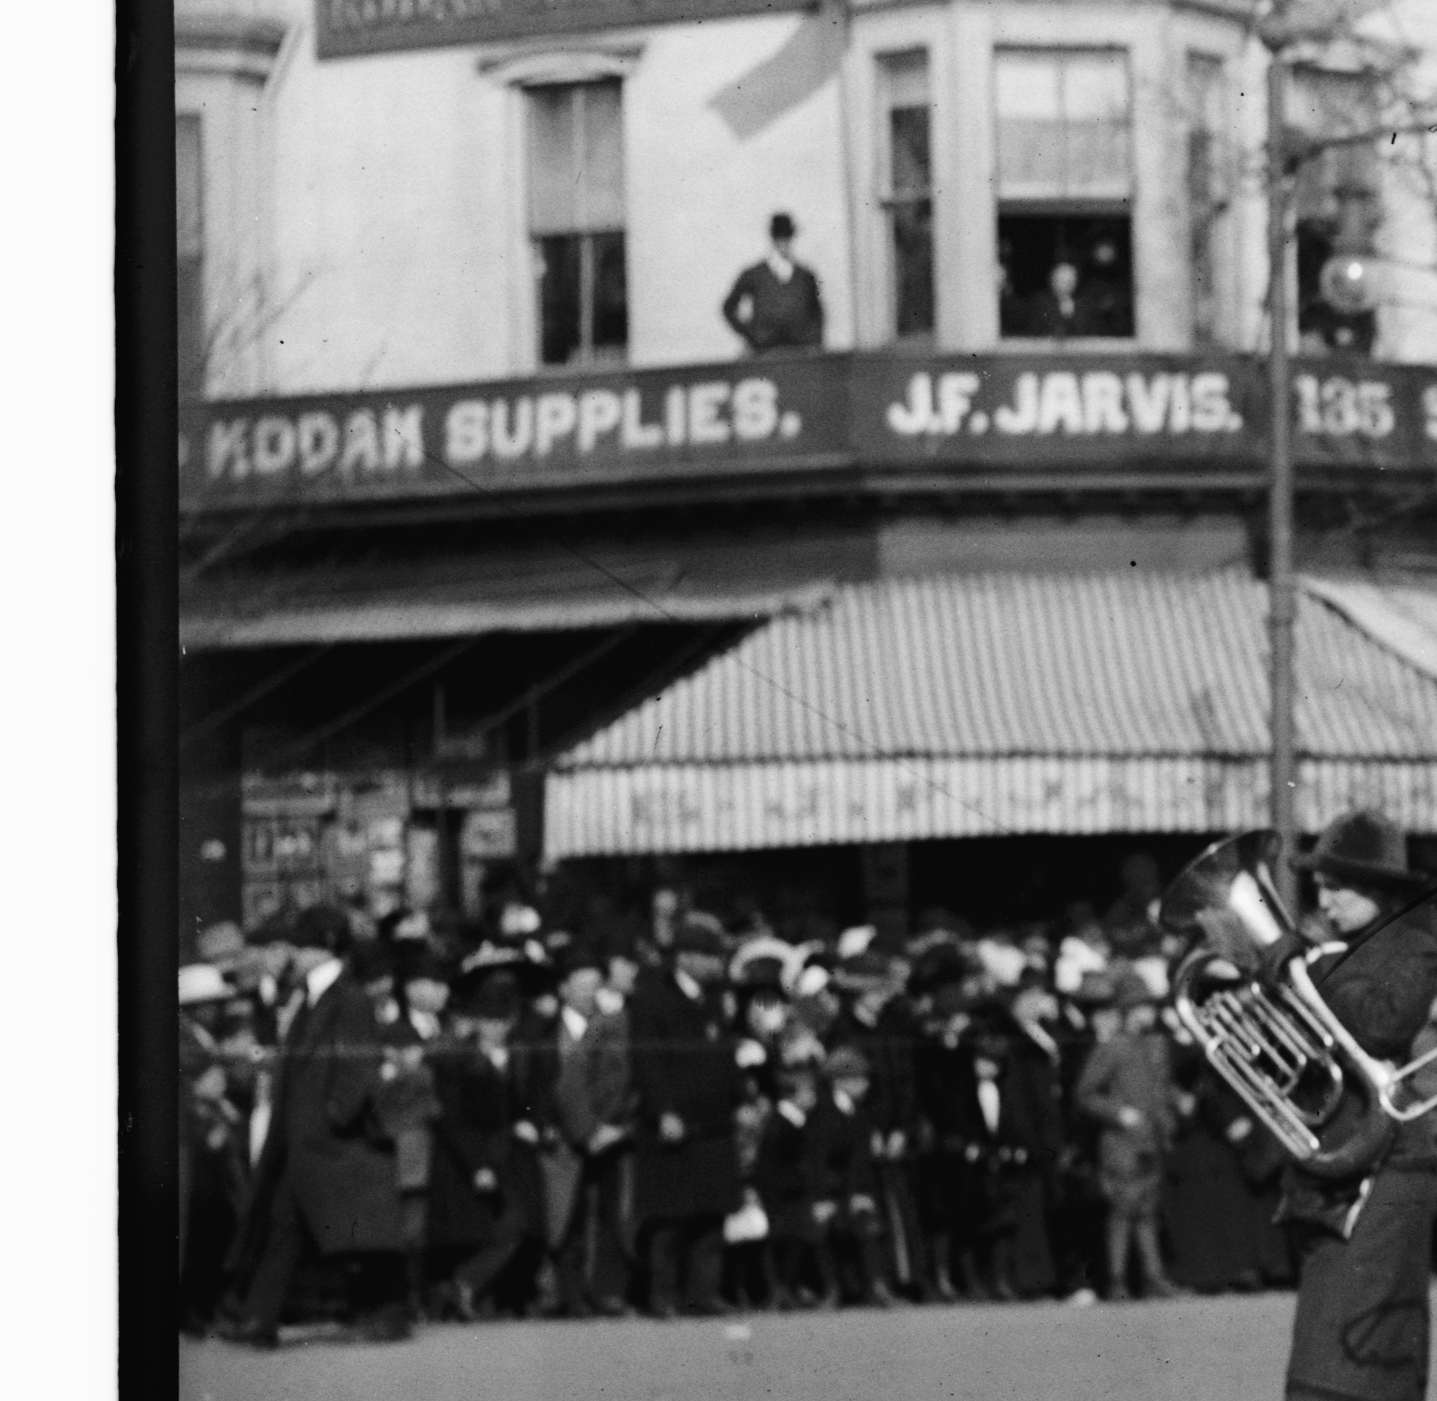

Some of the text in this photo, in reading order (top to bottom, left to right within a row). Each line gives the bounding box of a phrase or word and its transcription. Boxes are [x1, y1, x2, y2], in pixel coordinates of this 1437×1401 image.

[207, 403, 430, 478] KODAK
[445, 378, 802, 463] SUPPLIES.
[994, 372, 1243, 435] JARVIS.
